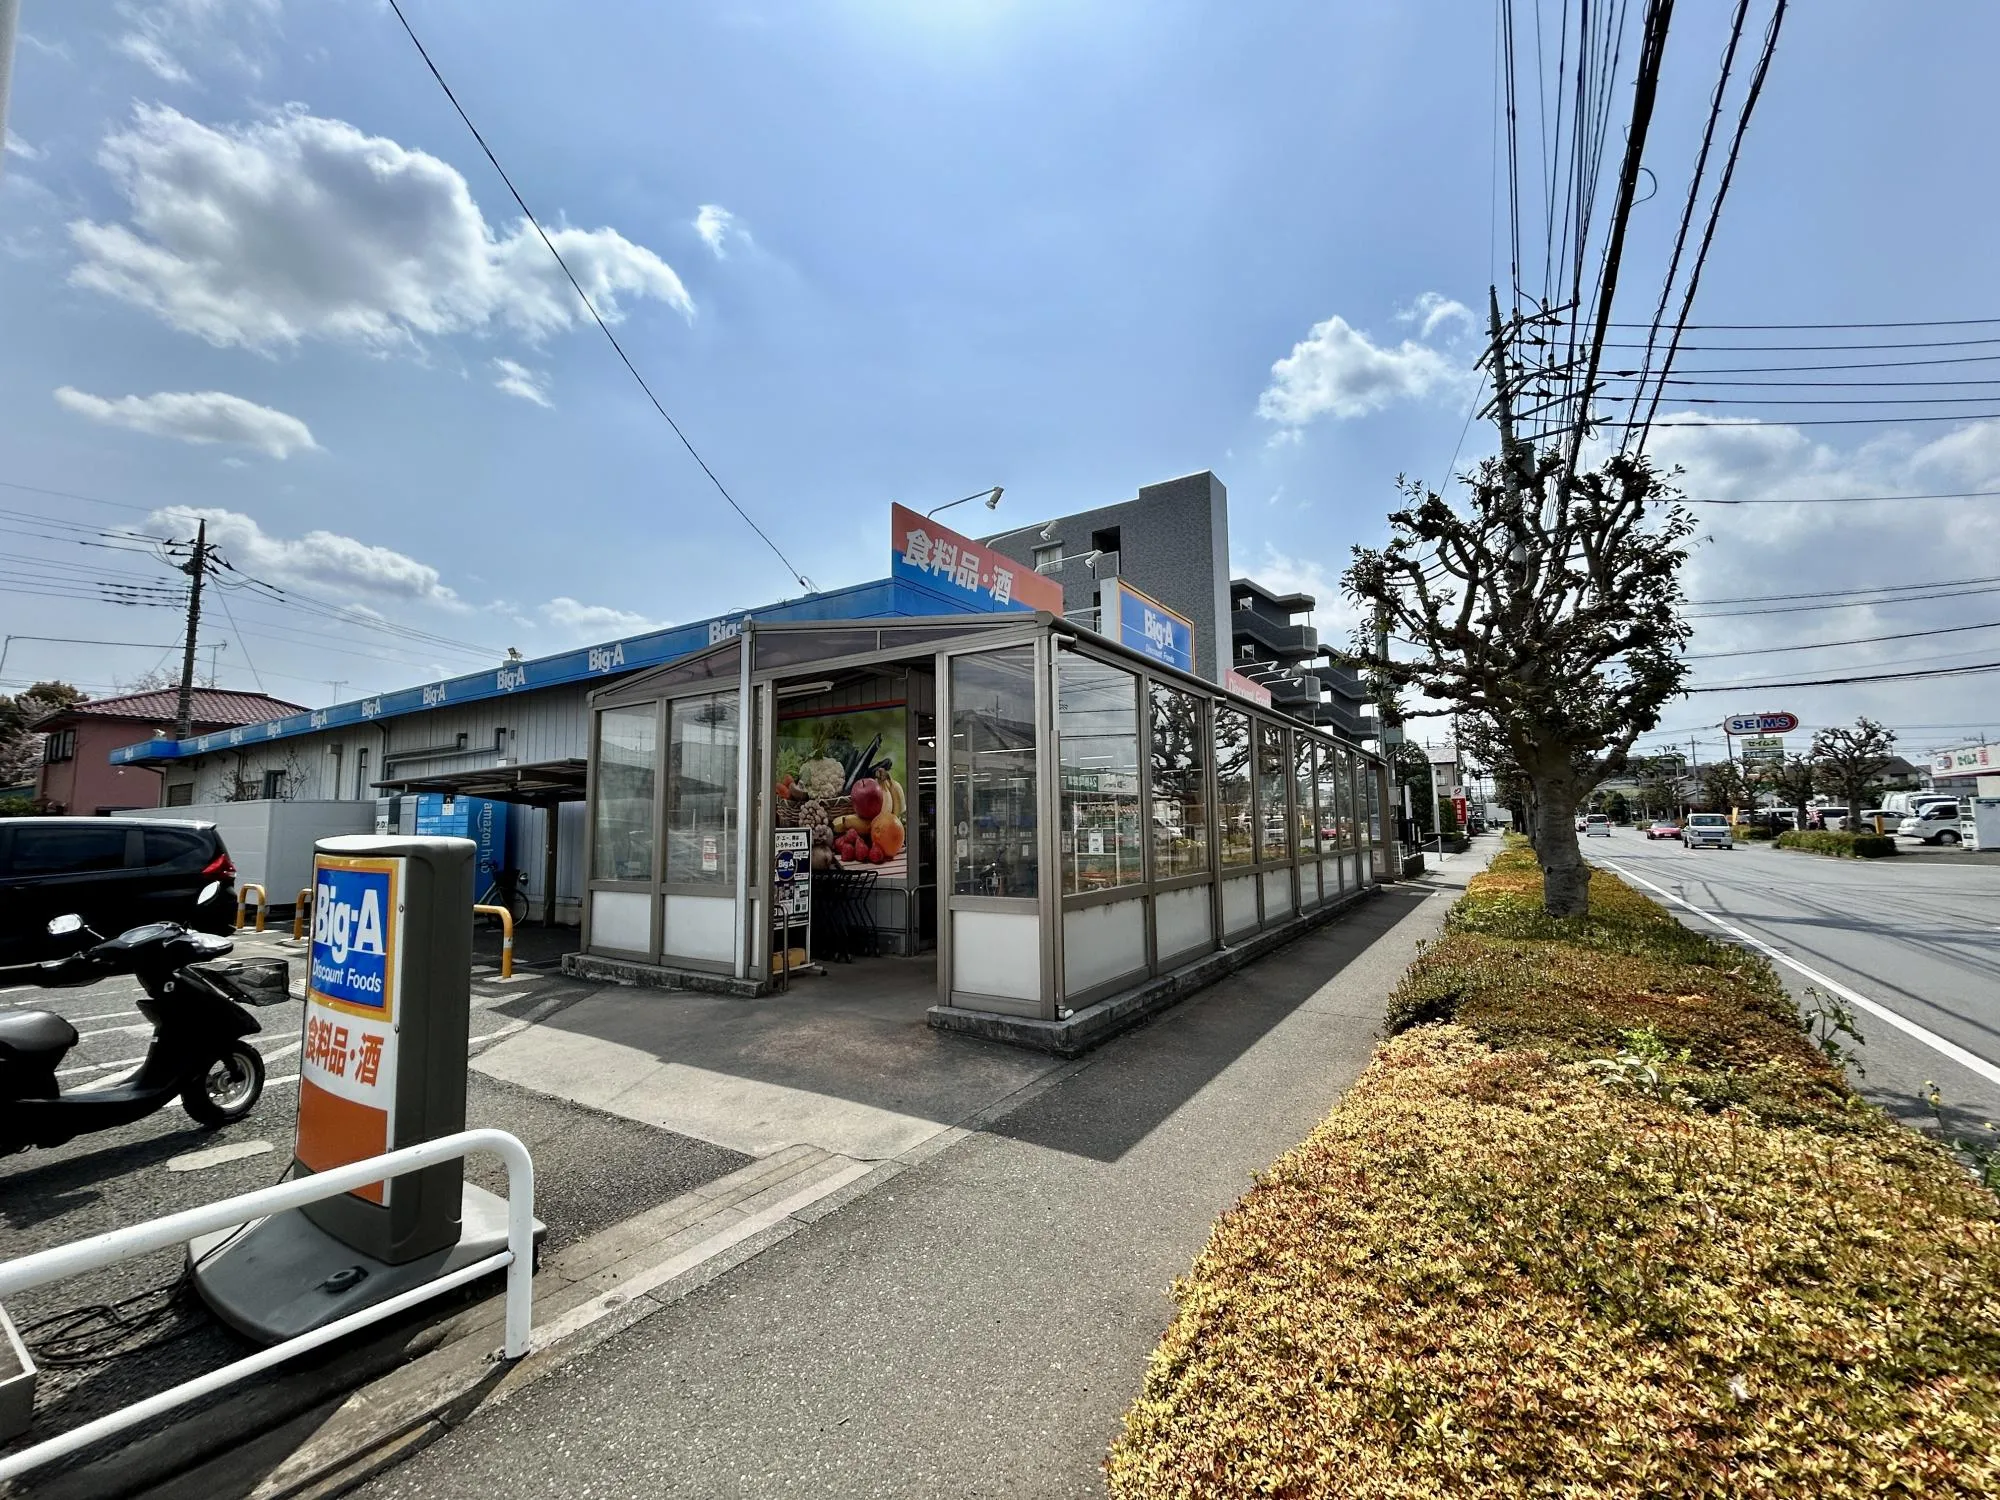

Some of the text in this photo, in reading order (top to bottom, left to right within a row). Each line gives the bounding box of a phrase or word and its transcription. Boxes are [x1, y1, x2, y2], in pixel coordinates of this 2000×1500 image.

[708, 619, 743, 647] Big-
[1144, 609, 1174, 649] Big-A
[588, 643, 625, 673] Big-A
[422, 683, 446, 707] Big-A
[496, 666, 526, 692] Big-A
[482, 802, 493, 846] amazon
[315, 883, 384, 964] Big-A
[312, 958, 382, 993] Discount Foods
[305, 1014, 385, 1087] 食料品・酒
